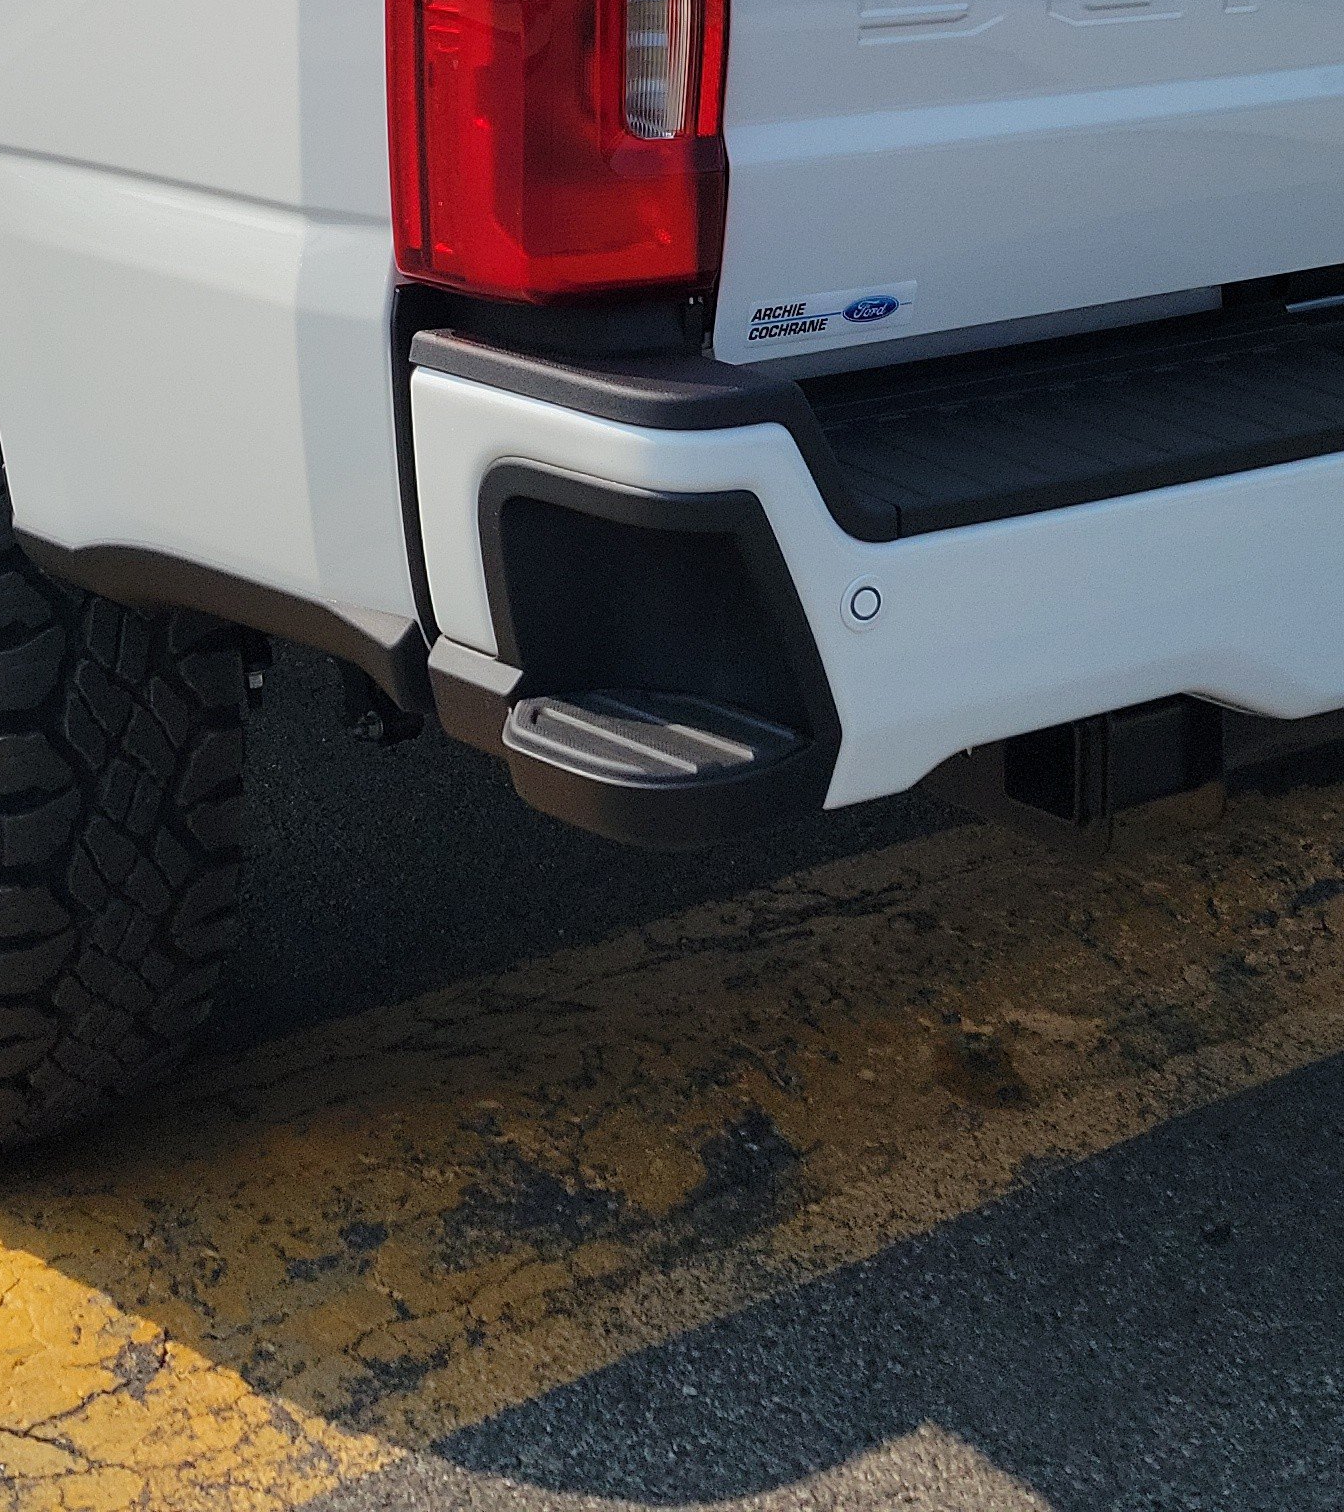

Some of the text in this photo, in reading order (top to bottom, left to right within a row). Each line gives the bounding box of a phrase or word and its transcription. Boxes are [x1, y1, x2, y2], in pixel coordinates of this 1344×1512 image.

[751, 302, 806, 322] ARCHIE
[853, 300, 886, 319] Ford
[748, 318, 828, 340] COCHRANE
